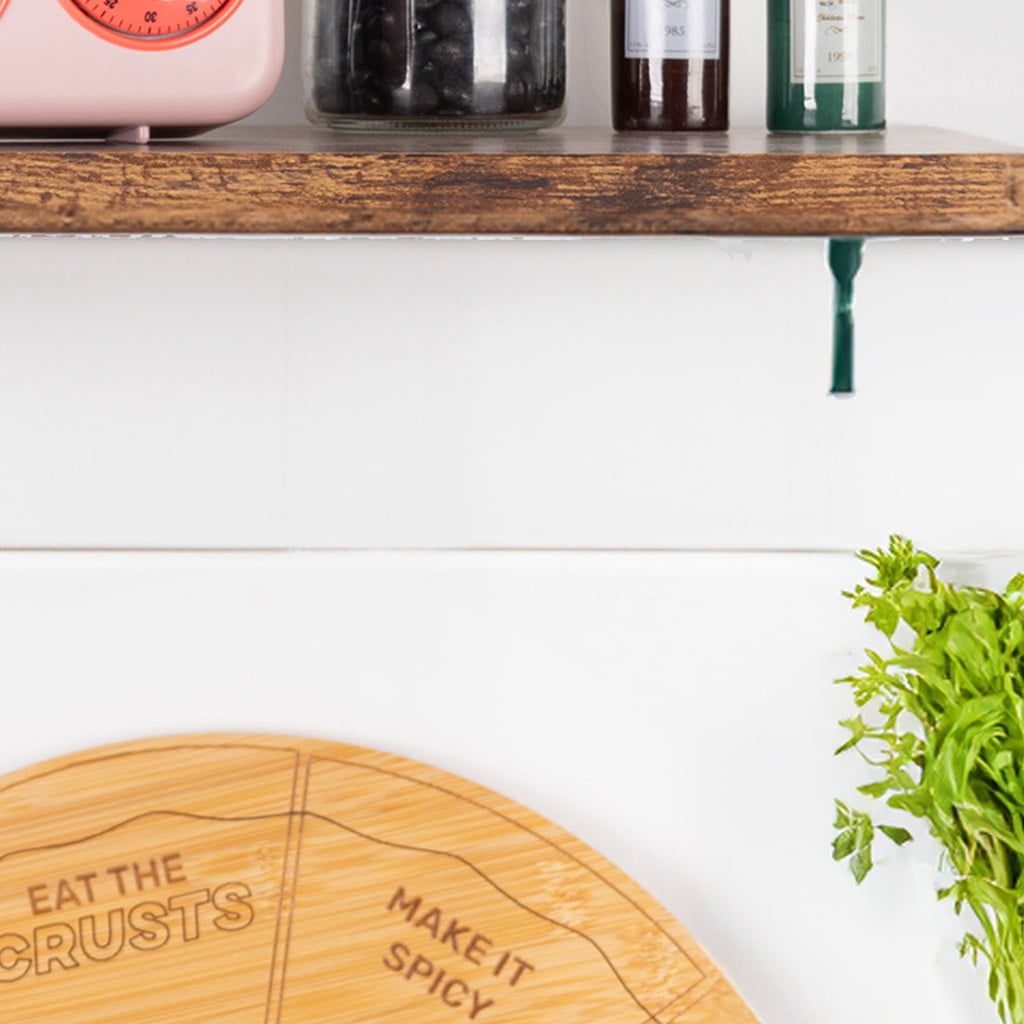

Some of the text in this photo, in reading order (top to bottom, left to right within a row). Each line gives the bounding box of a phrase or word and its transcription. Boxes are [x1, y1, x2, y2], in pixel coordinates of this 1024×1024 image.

[144, 11, 158, 23] 30
[185, 1, 199, 15] 35
[27, 853, 187, 916] EAT THE
[386, 886, 536, 987] MAKE IT
[382, 942, 495, 1020] SPICY
